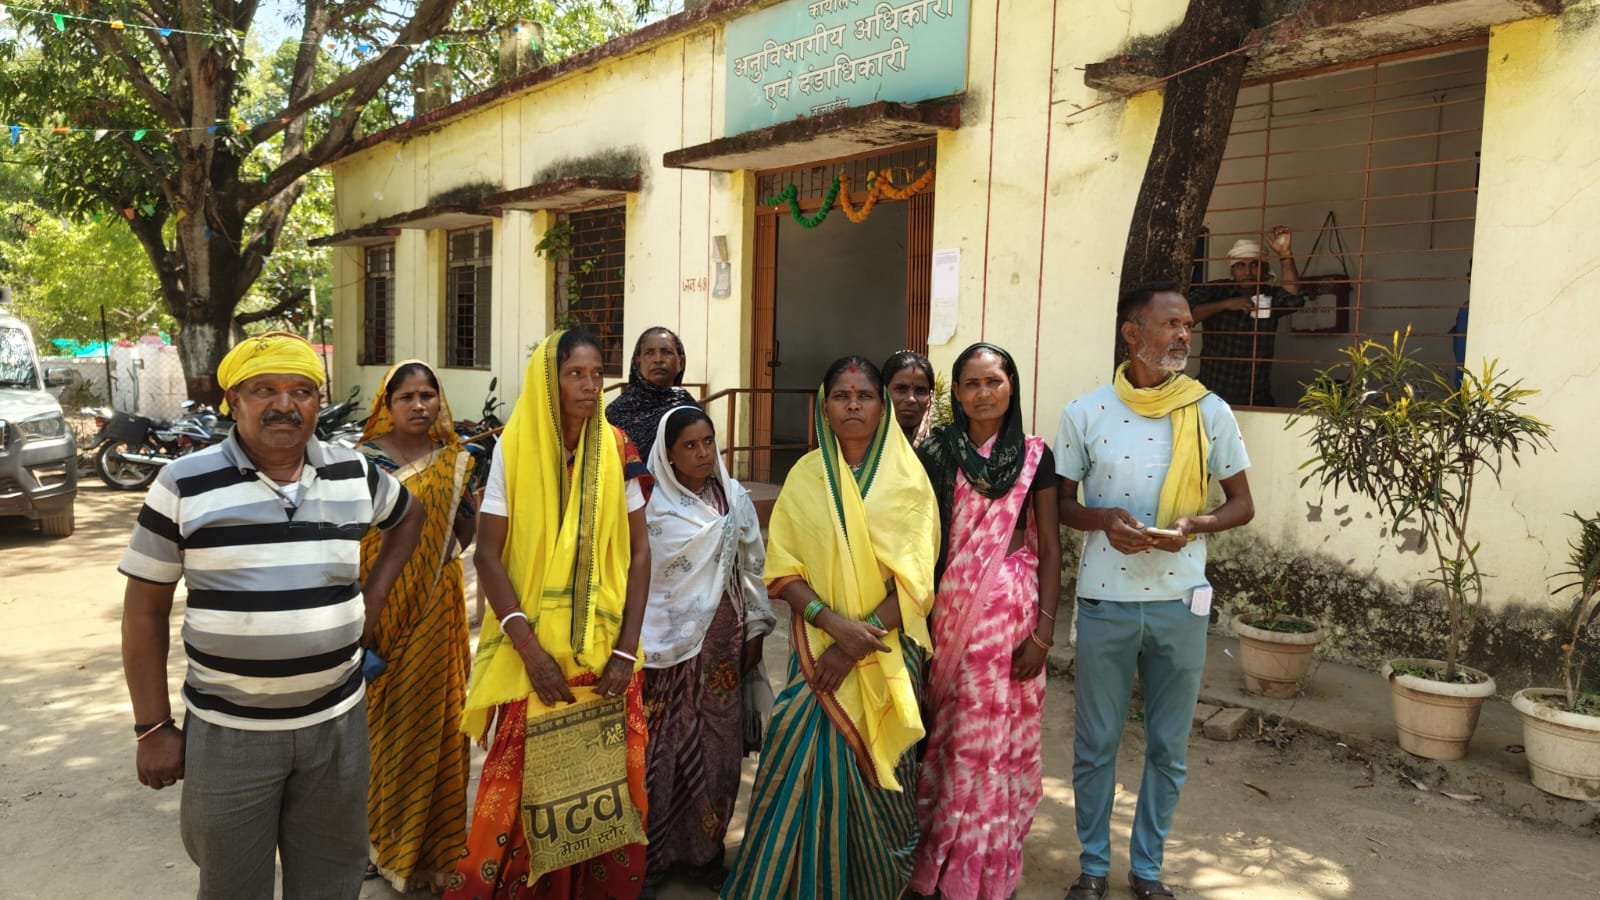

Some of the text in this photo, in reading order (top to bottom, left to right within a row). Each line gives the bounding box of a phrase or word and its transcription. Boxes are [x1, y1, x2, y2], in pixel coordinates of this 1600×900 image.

[734, 23, 846, 83] अनुविभागीय
[763, 37, 909, 109] एवं दंडाधिकारी
[560, 824, 627, 857] मेगा स्टोर
